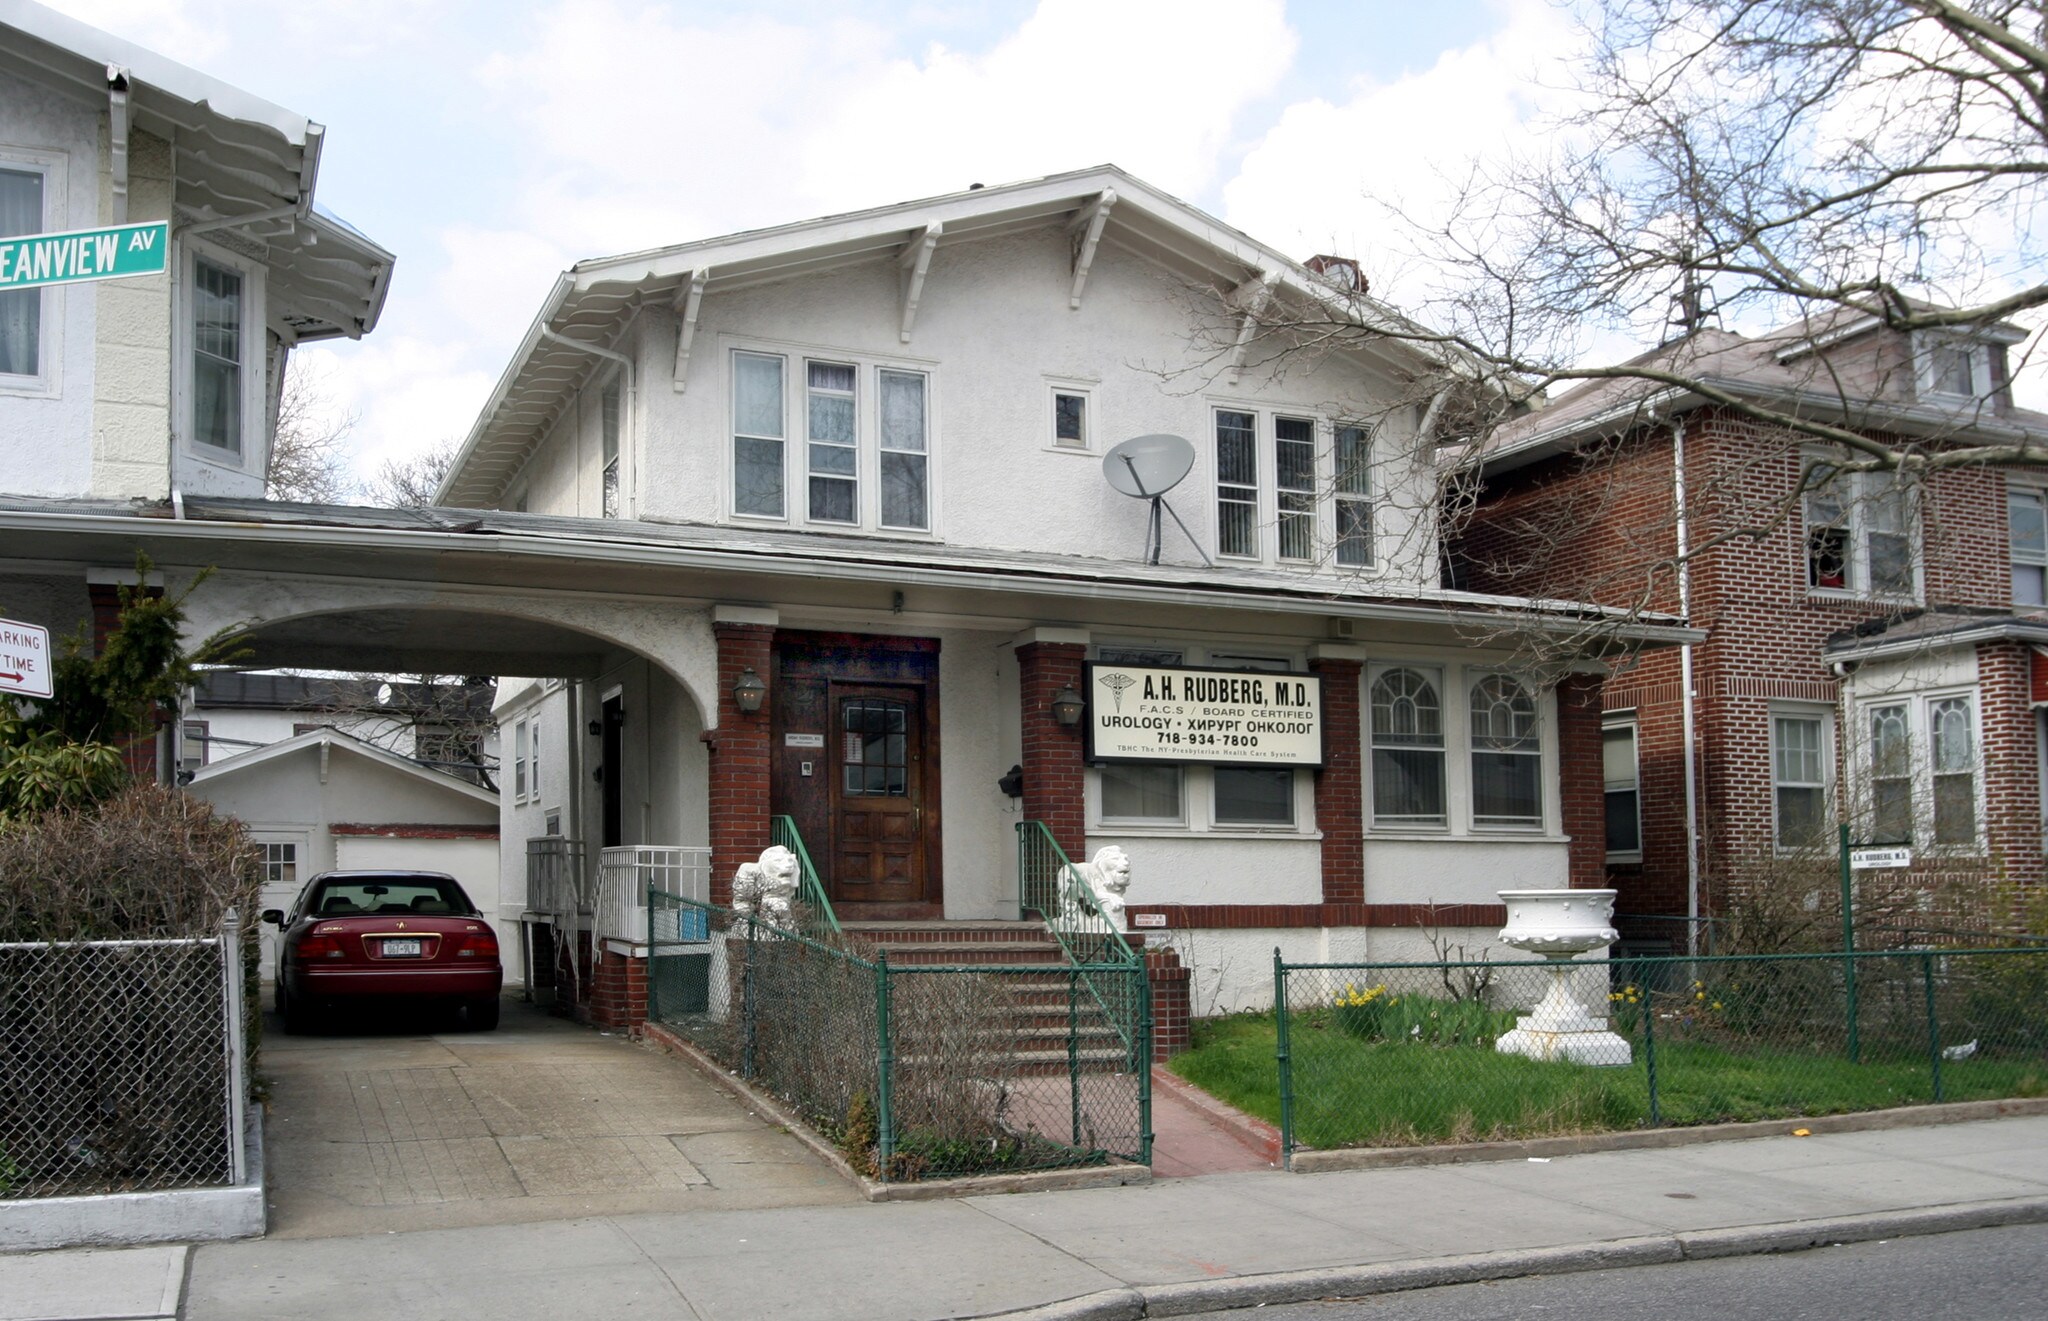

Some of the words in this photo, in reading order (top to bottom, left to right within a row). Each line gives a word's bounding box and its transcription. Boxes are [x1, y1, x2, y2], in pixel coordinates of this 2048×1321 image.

[0, 234, 119, 283] EANVIEW
[128, 229, 156, 252] AV
[0, 654, 35, 672] TIME
[1143, 674, 1176, 701] A.H.
[1184, 676, 1268, 708] RUDBERG,
[1275, 681, 1311, 707] M.D.
[1140, 704, 1184, 715] F.A.C.S
[1203, 707, 1245, 717] BOARD
[1251, 709, 1313, 720] CERTIFIED
[1101, 715, 1172, 729] UROLOGY
[1187, 718, 1242, 732] ХИРУРГ
[1246, 721, 1313, 735] ОНКОЛОГ
[1157, 732, 1258, 747] 718-934-7800
[1141, 745, 1155, 753] The
